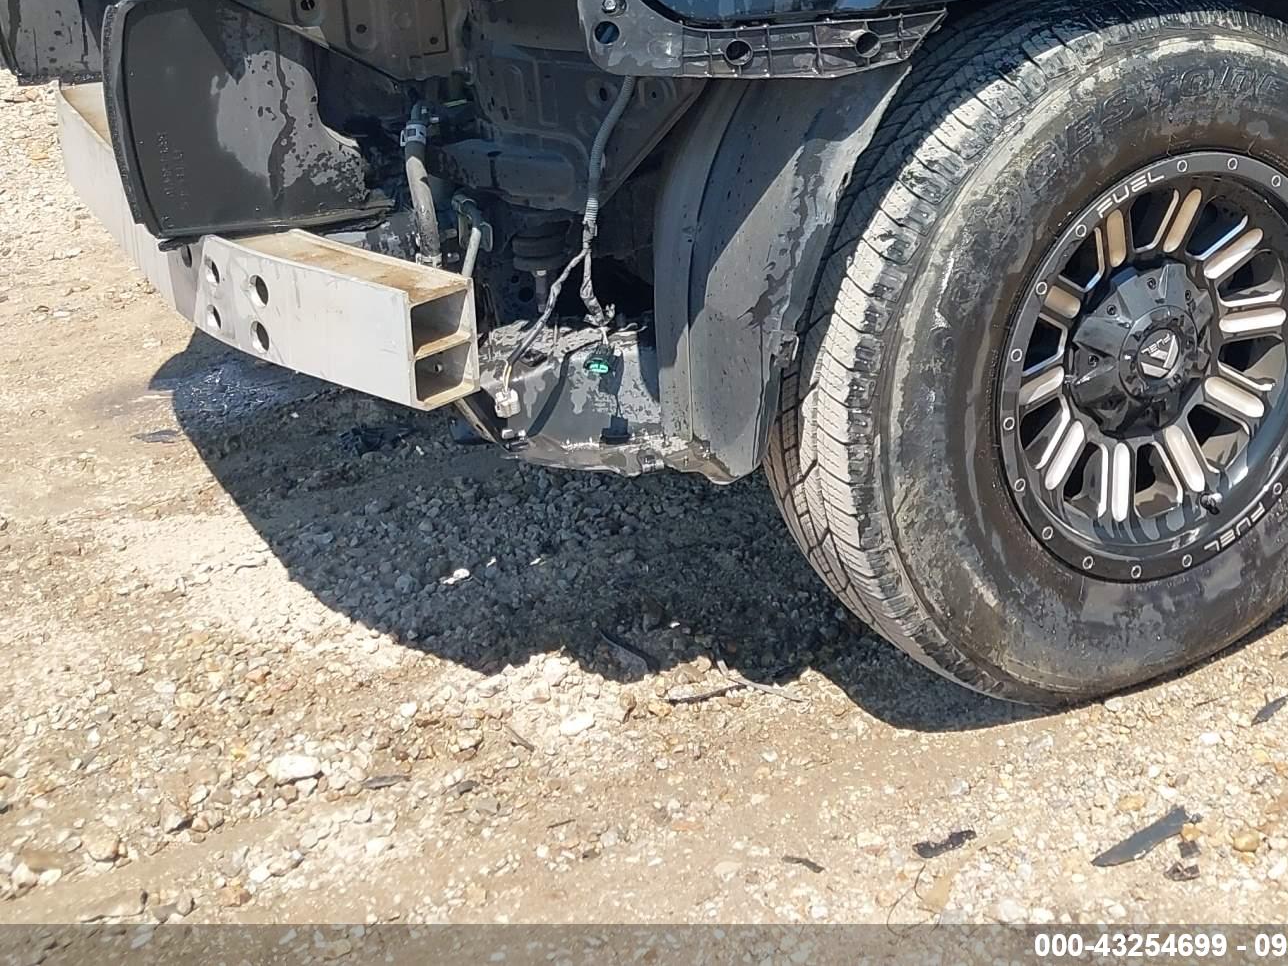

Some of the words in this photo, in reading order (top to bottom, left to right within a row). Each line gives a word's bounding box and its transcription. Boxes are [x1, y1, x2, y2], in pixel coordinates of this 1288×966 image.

[1096, 171, 1165, 219] FUEL
[1140, 333, 1171, 354] FUEL
[1203, 501, 1266, 552] FUEL
